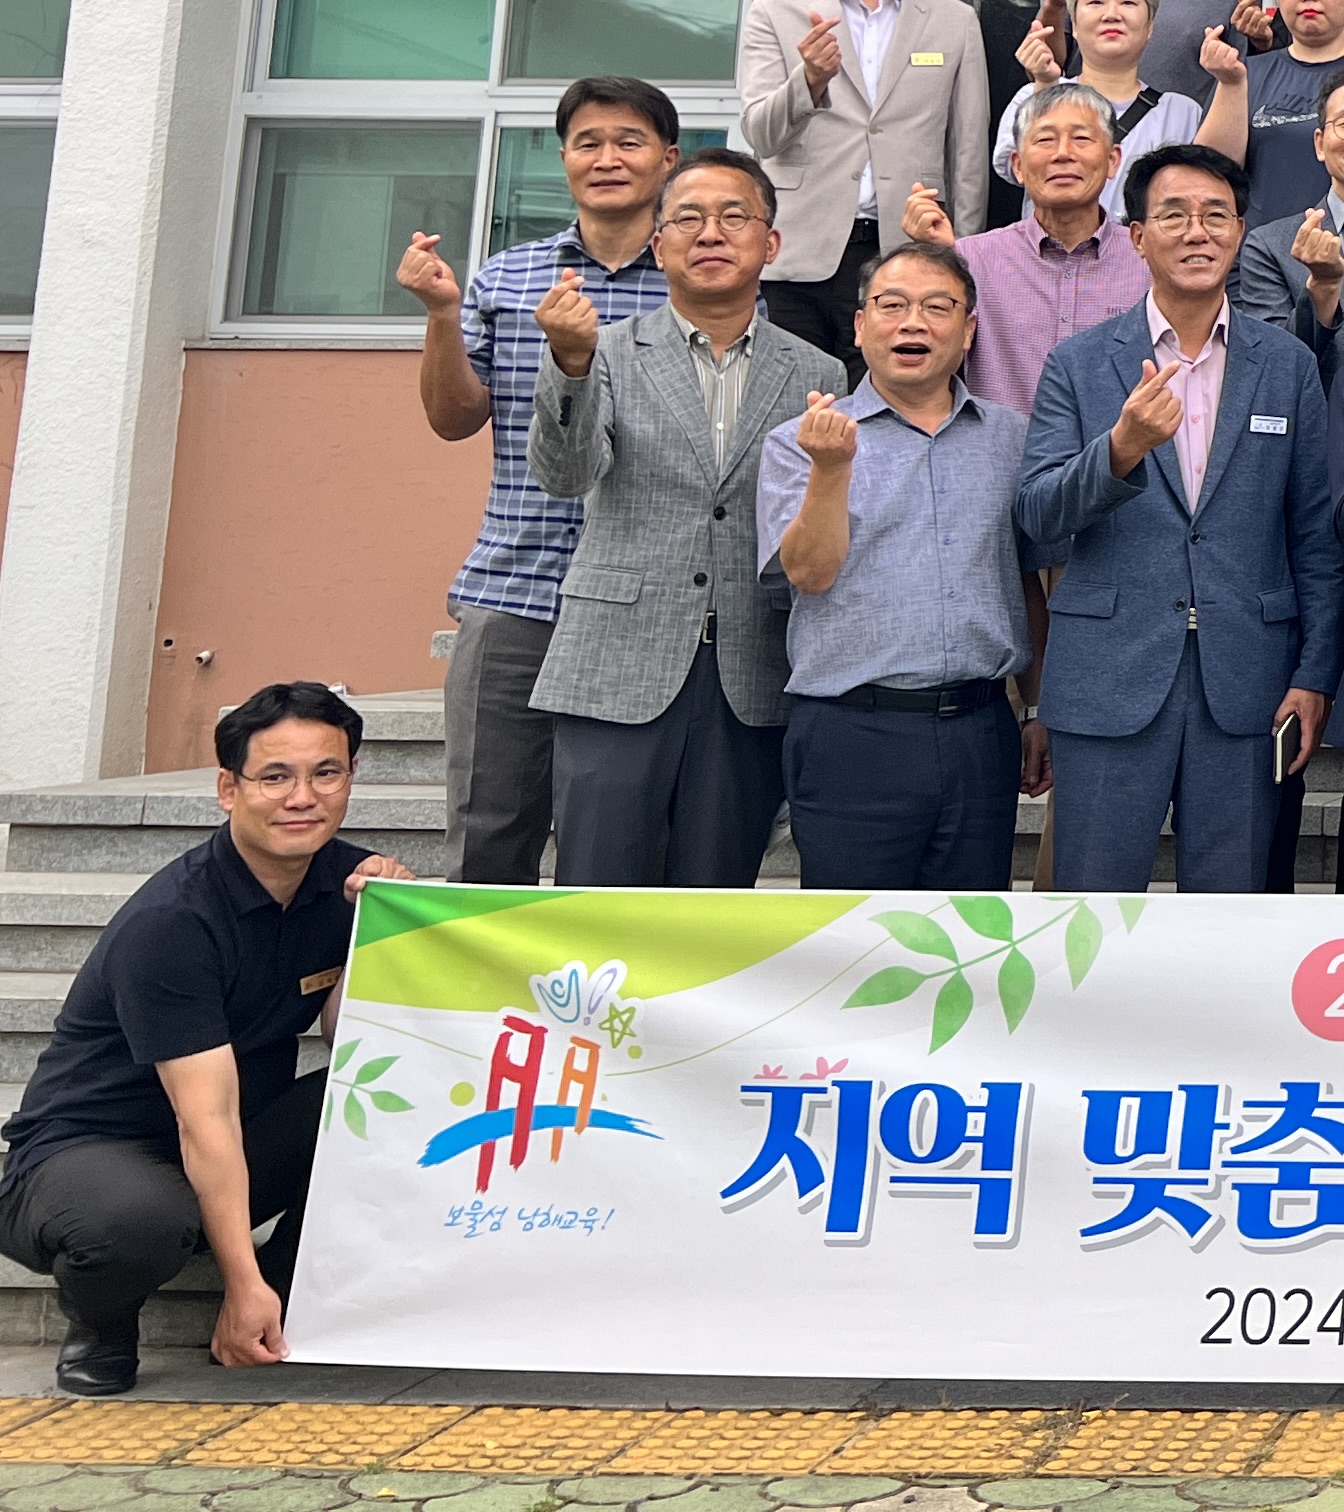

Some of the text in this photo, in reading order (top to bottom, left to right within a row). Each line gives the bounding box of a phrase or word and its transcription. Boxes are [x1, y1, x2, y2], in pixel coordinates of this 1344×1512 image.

[719, 1079, 1023, 1236] 지역
[443, 1199, 616, 1239] 보물섬 남해교육!
